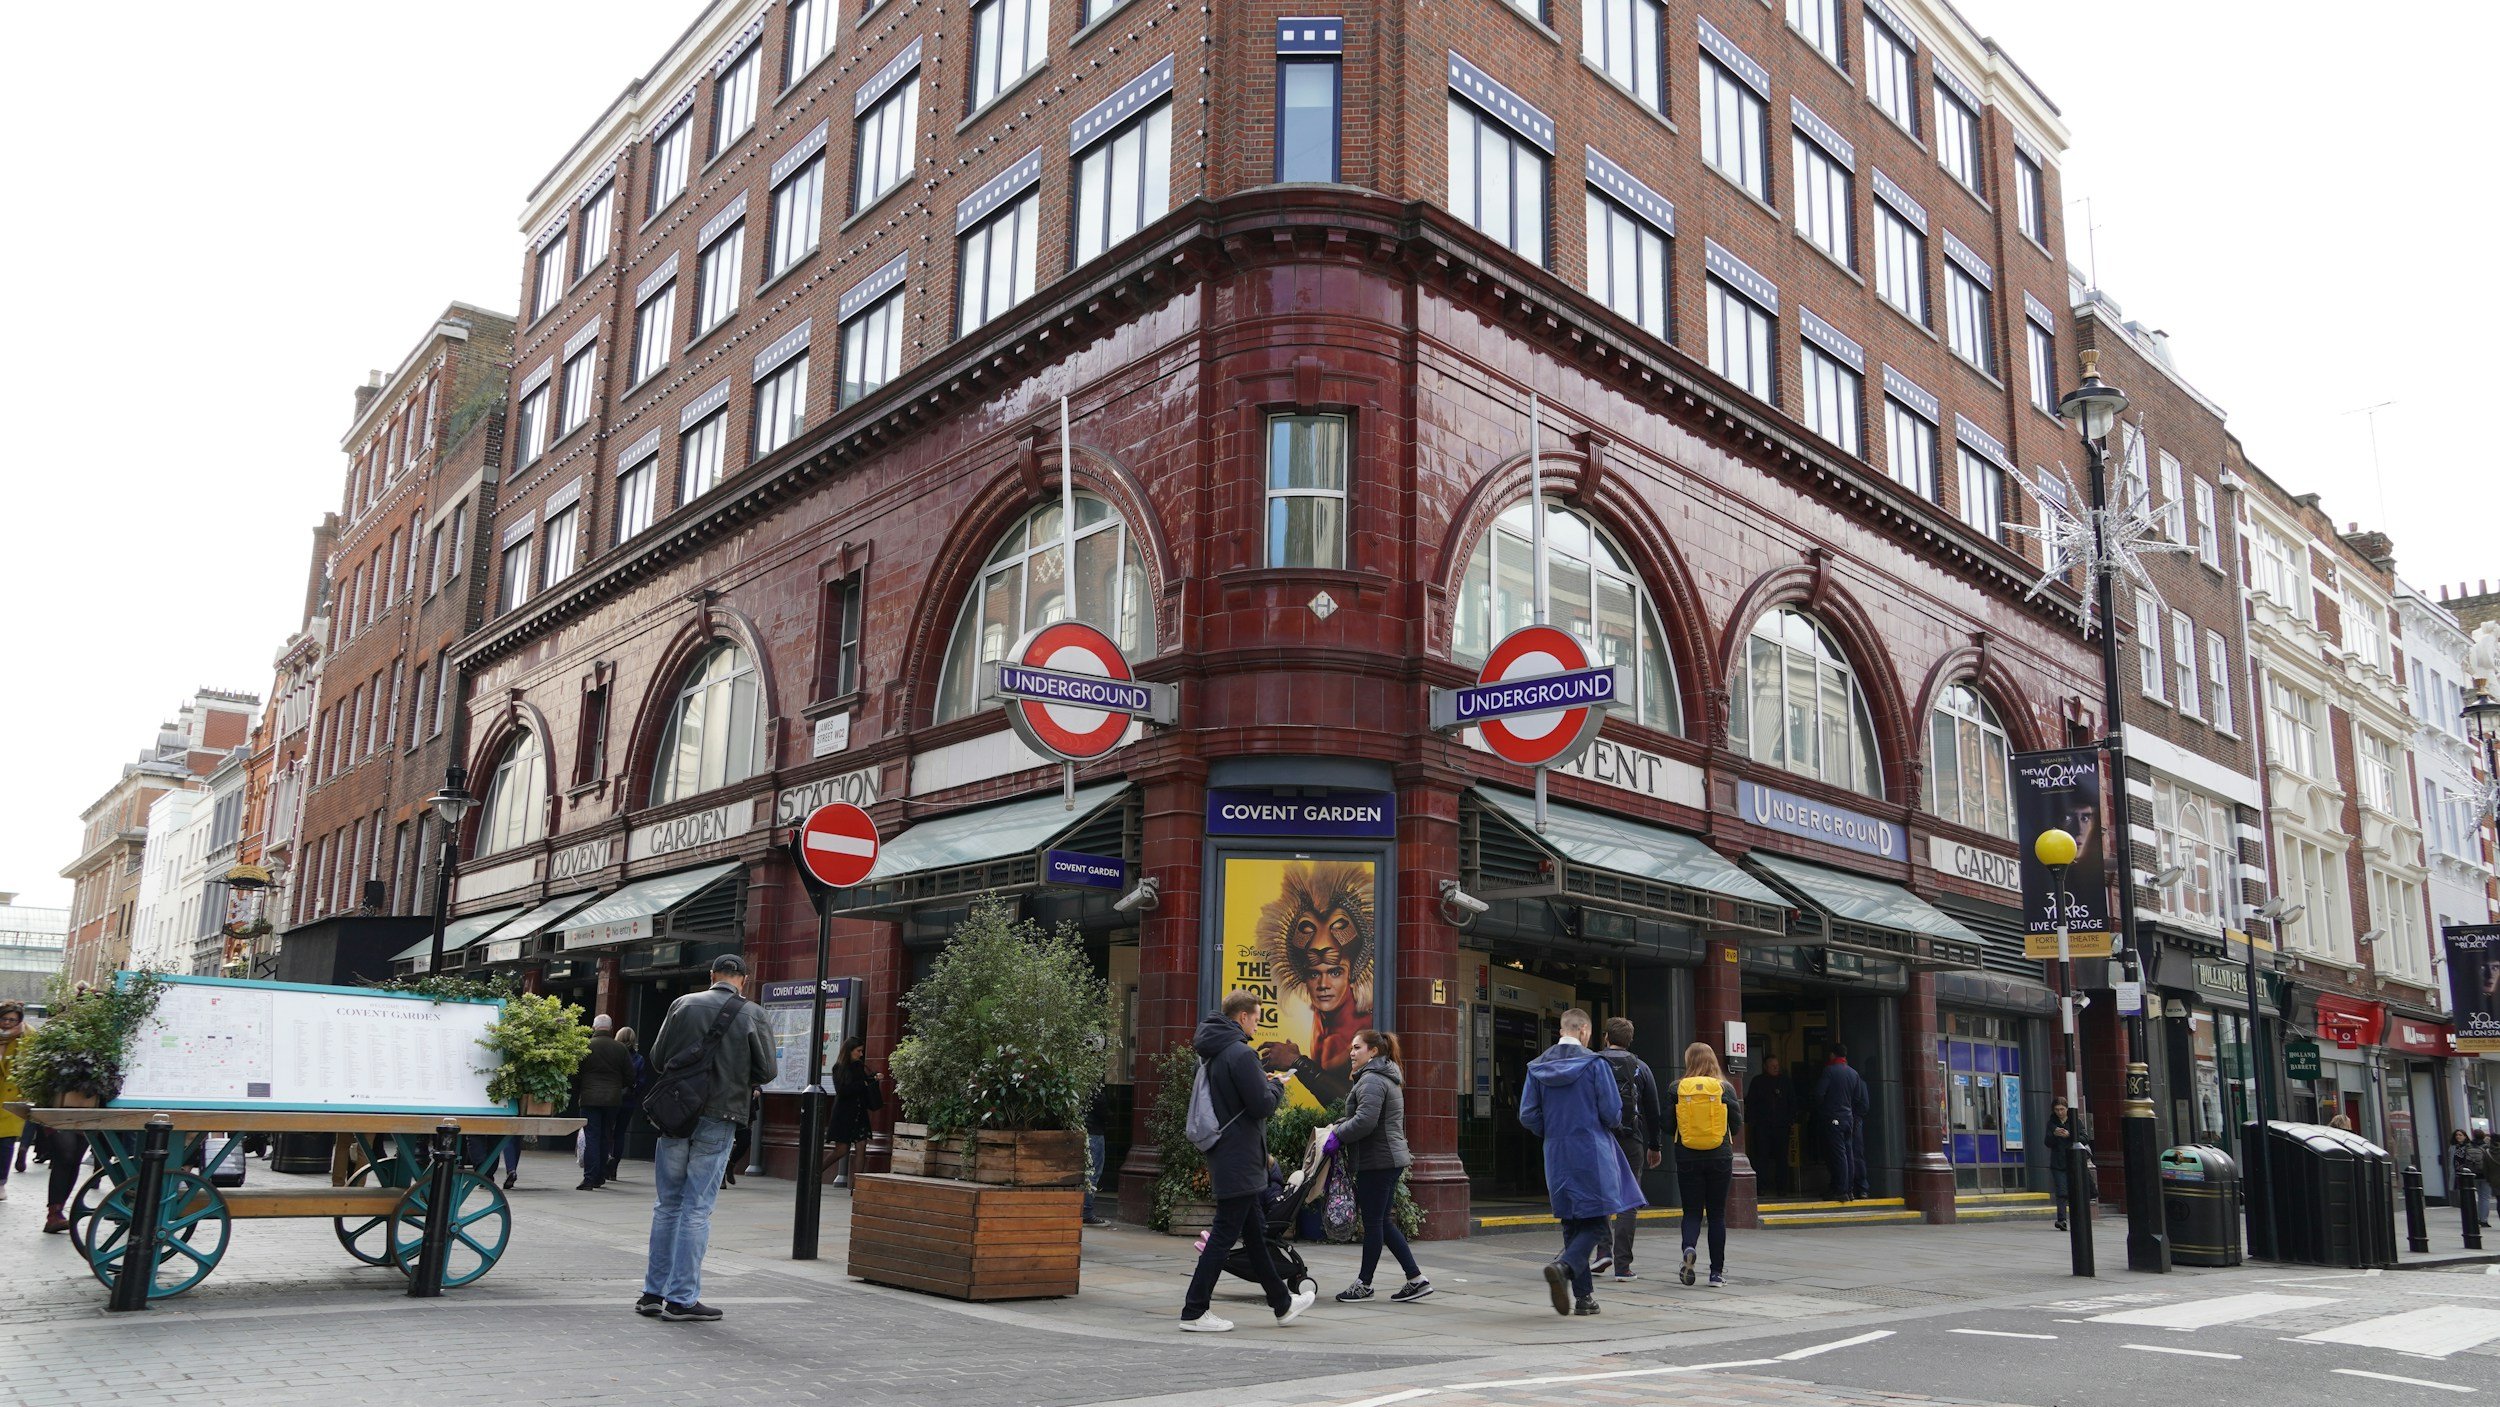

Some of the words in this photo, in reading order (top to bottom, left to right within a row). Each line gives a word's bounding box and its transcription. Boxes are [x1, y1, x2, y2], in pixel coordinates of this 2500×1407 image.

[1315, 597, 1330, 614] H
[1004, 669, 1147, 709] UNDERGROUND
[1459, 674, 1612, 716] UNDERGROUND
[817, 720, 833, 733] JAMES
[816, 731, 833, 745] STREET
[834, 728, 845, 739] WC2
[1560, 738, 1662, 793] VENT
[2033, 763, 2095, 780] WOMAN
[2038, 775, 2077, 788] BLACK
[1221, 804, 1298, 821] COVENT
[1303, 806, 1381, 822] GARDEN
[1753, 785, 1893, 856] UNDERGROUND
[650, 807, 728, 854] GARDEN
[551, 839, 611, 879] COVENT
[1054, 862, 1087, 873] COVENT
[1088, 866, 1120, 877] GARDEN
[1955, 845, 2023, 890] GARDE
[612, 926, 619, 936] No
[620, 926, 632, 936] entry
[2030, 921, 2050, 931] LIVE
[2070, 919, 2103, 930] STAGE
[2035, 936, 2058, 944] FORTU
[2455, 934, 2500, 944] WOMAN
[2460, 941, 2488, 949] BLACK
[1237, 961, 1271, 977] THE
[2199, 964, 2231, 987] HOLLAND
[2231, 971, 2239, 992] &
[773, 986, 794, 997] COVENT
[794, 984, 816, 996] GARDEN
[1433, 981, 1444, 1002] H
[336, 1007, 390, 1018] COVENT
[391, 1010, 441, 1020] GARDEN
[2469, 1012, 2490, 1023] 30
[2468, 1020, 2500, 1029] YEARS
[1732, 1043, 1746, 1053] LFB
